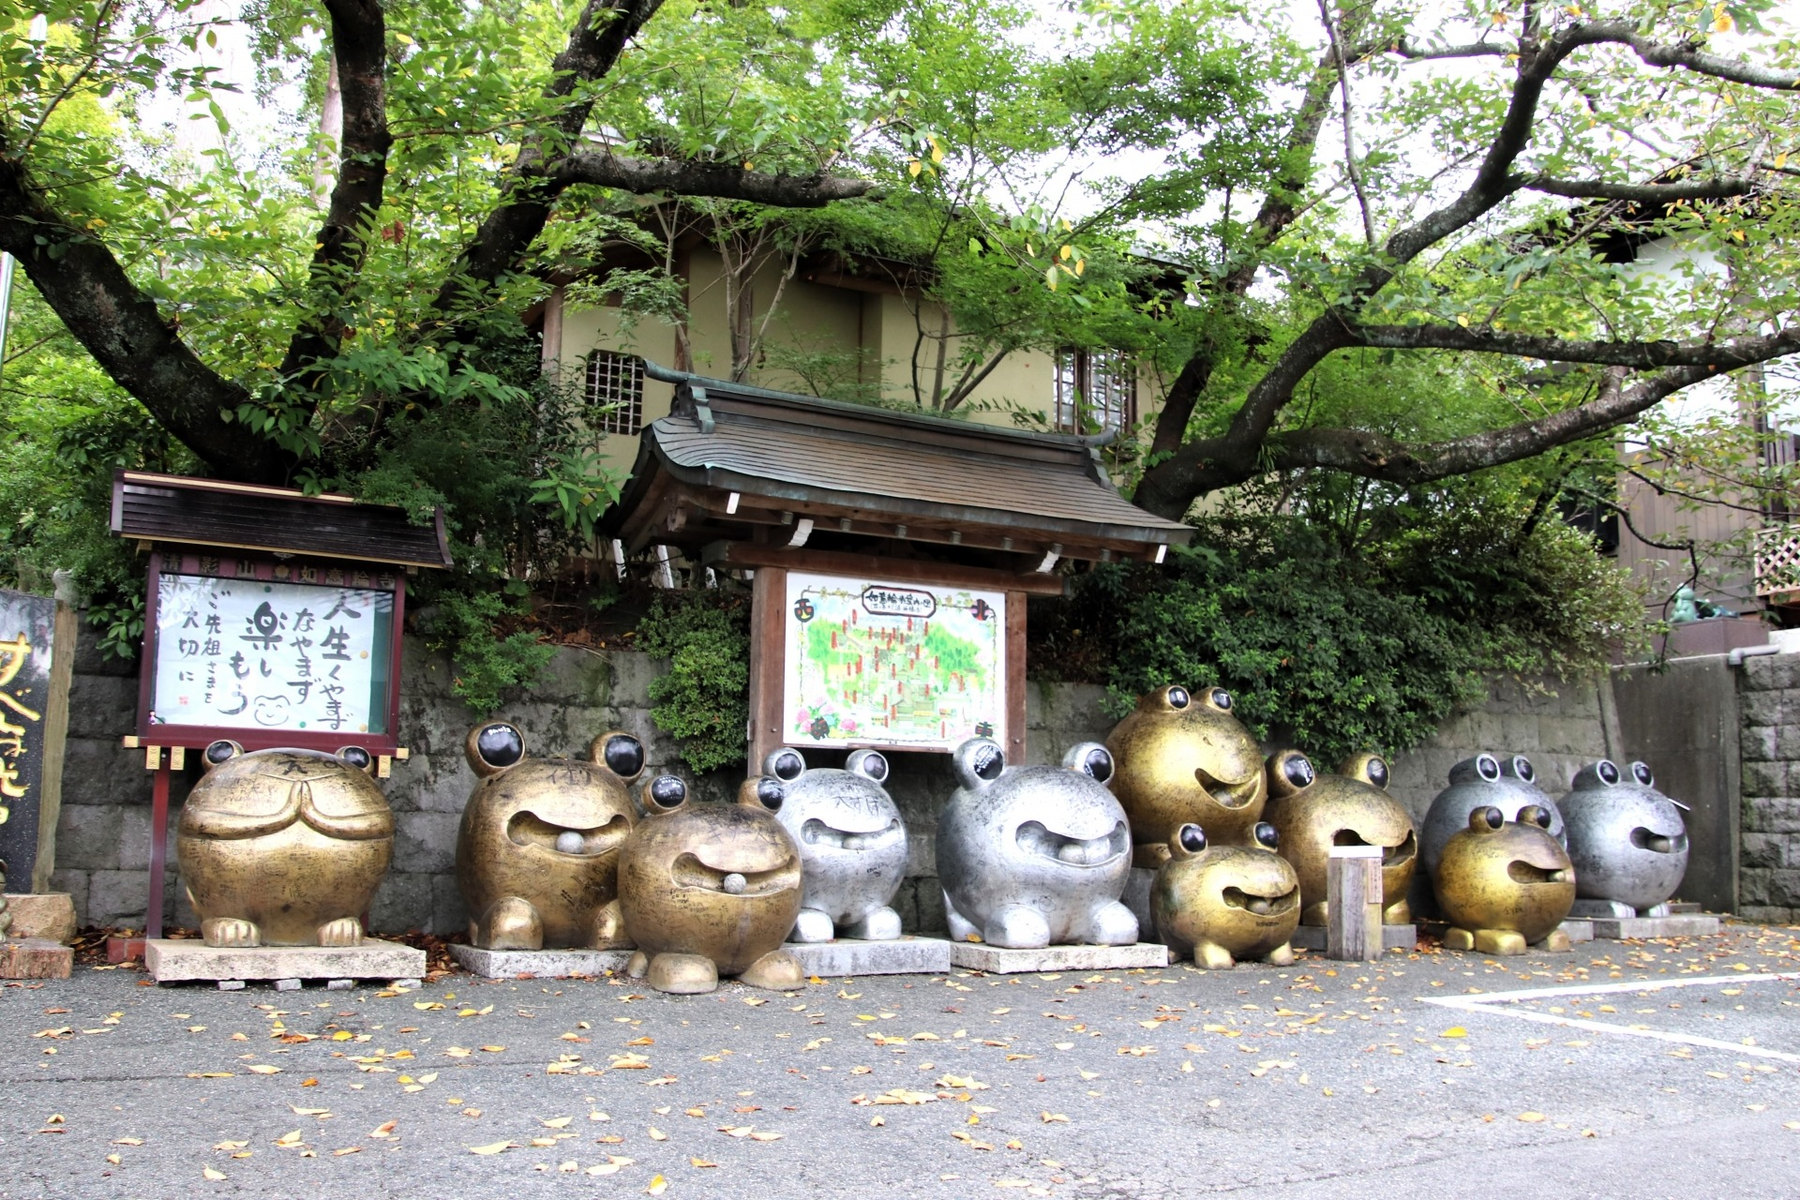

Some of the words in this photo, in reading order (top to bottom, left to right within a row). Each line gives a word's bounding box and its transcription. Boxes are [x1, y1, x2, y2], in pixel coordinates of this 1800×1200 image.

[178, 609, 200, 682] 大切に
[201, 590, 231, 704] ご先祖さまを
[794, 598, 815, 622] 西
[287, 607, 322, 705] なやまず
[317, 591, 361, 730] 人生くやまず
[975, 722, 993, 739] 東
